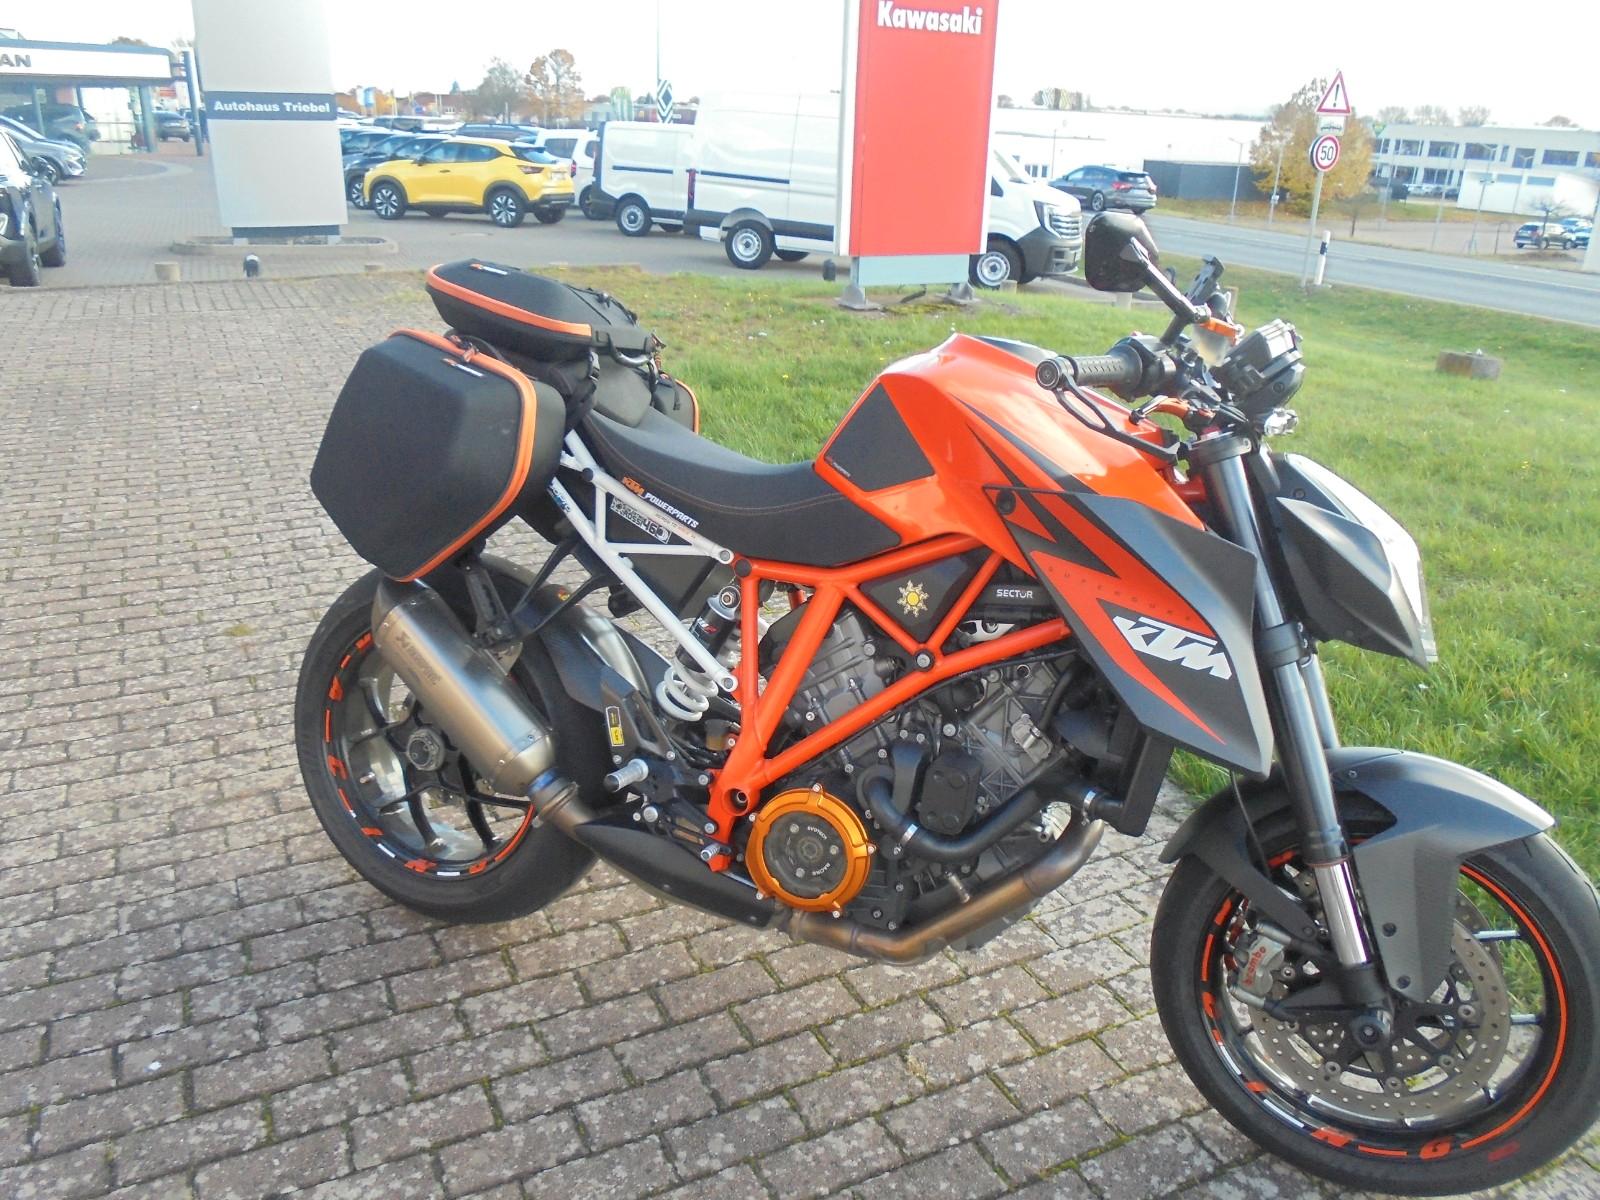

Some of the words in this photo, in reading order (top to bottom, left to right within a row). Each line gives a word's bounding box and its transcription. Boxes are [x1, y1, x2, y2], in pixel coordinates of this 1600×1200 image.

[877, 1, 983, 35] Kawasaki
[214, 100, 280, 113] Autohaus
[283, 101, 331, 114] Triebel
[1320, 145, 1334, 161] 50
[644, 492, 699, 529] POWERPARTS
[996, 588, 1033, 599] SECTOR
[1113, 615, 1232, 680] KTM
[1240, 946, 1267, 987] brembo
